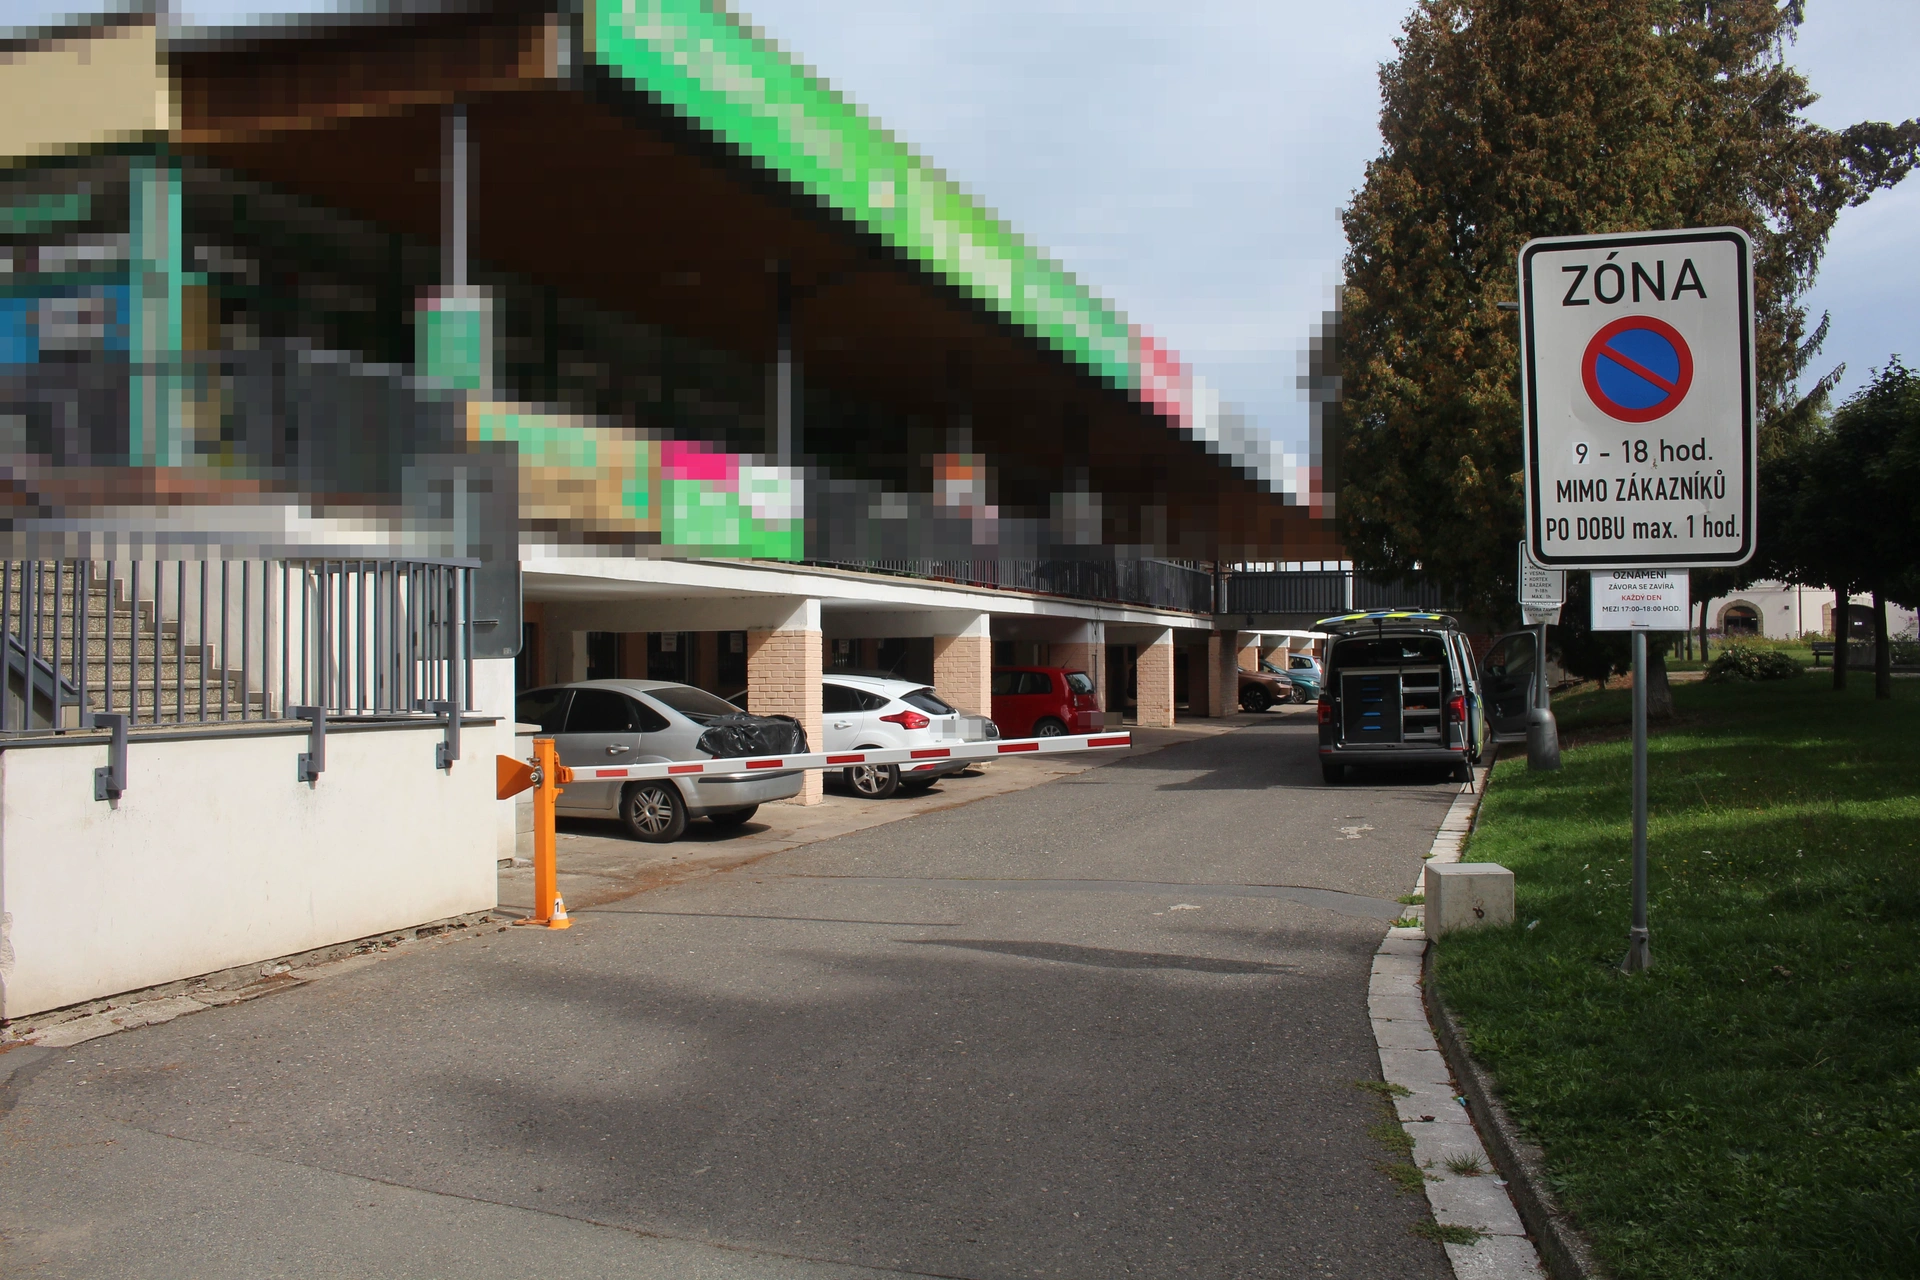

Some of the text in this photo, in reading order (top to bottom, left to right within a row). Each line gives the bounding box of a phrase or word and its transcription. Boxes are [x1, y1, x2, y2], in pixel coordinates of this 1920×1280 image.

[1562, 252, 1707, 306] ZÓNA
[1575, 443, 1588, 463] 9
[1622, 440, 1648, 463] 18
[1660, 437, 1713, 462] hod.
[1556, 469, 1725, 503] MIMO ZÁKAZNÍKŮ
[1546, 514, 1740, 541] PO DOBU max. 1 hod.
[1608, 582, 1637, 590] ZÁVORA
[1649, 582, 1674, 590] ZAVÍRÁ
[1621, 593, 1645, 601] KAŽDÝ
[555, 901, 560, 913] 1
